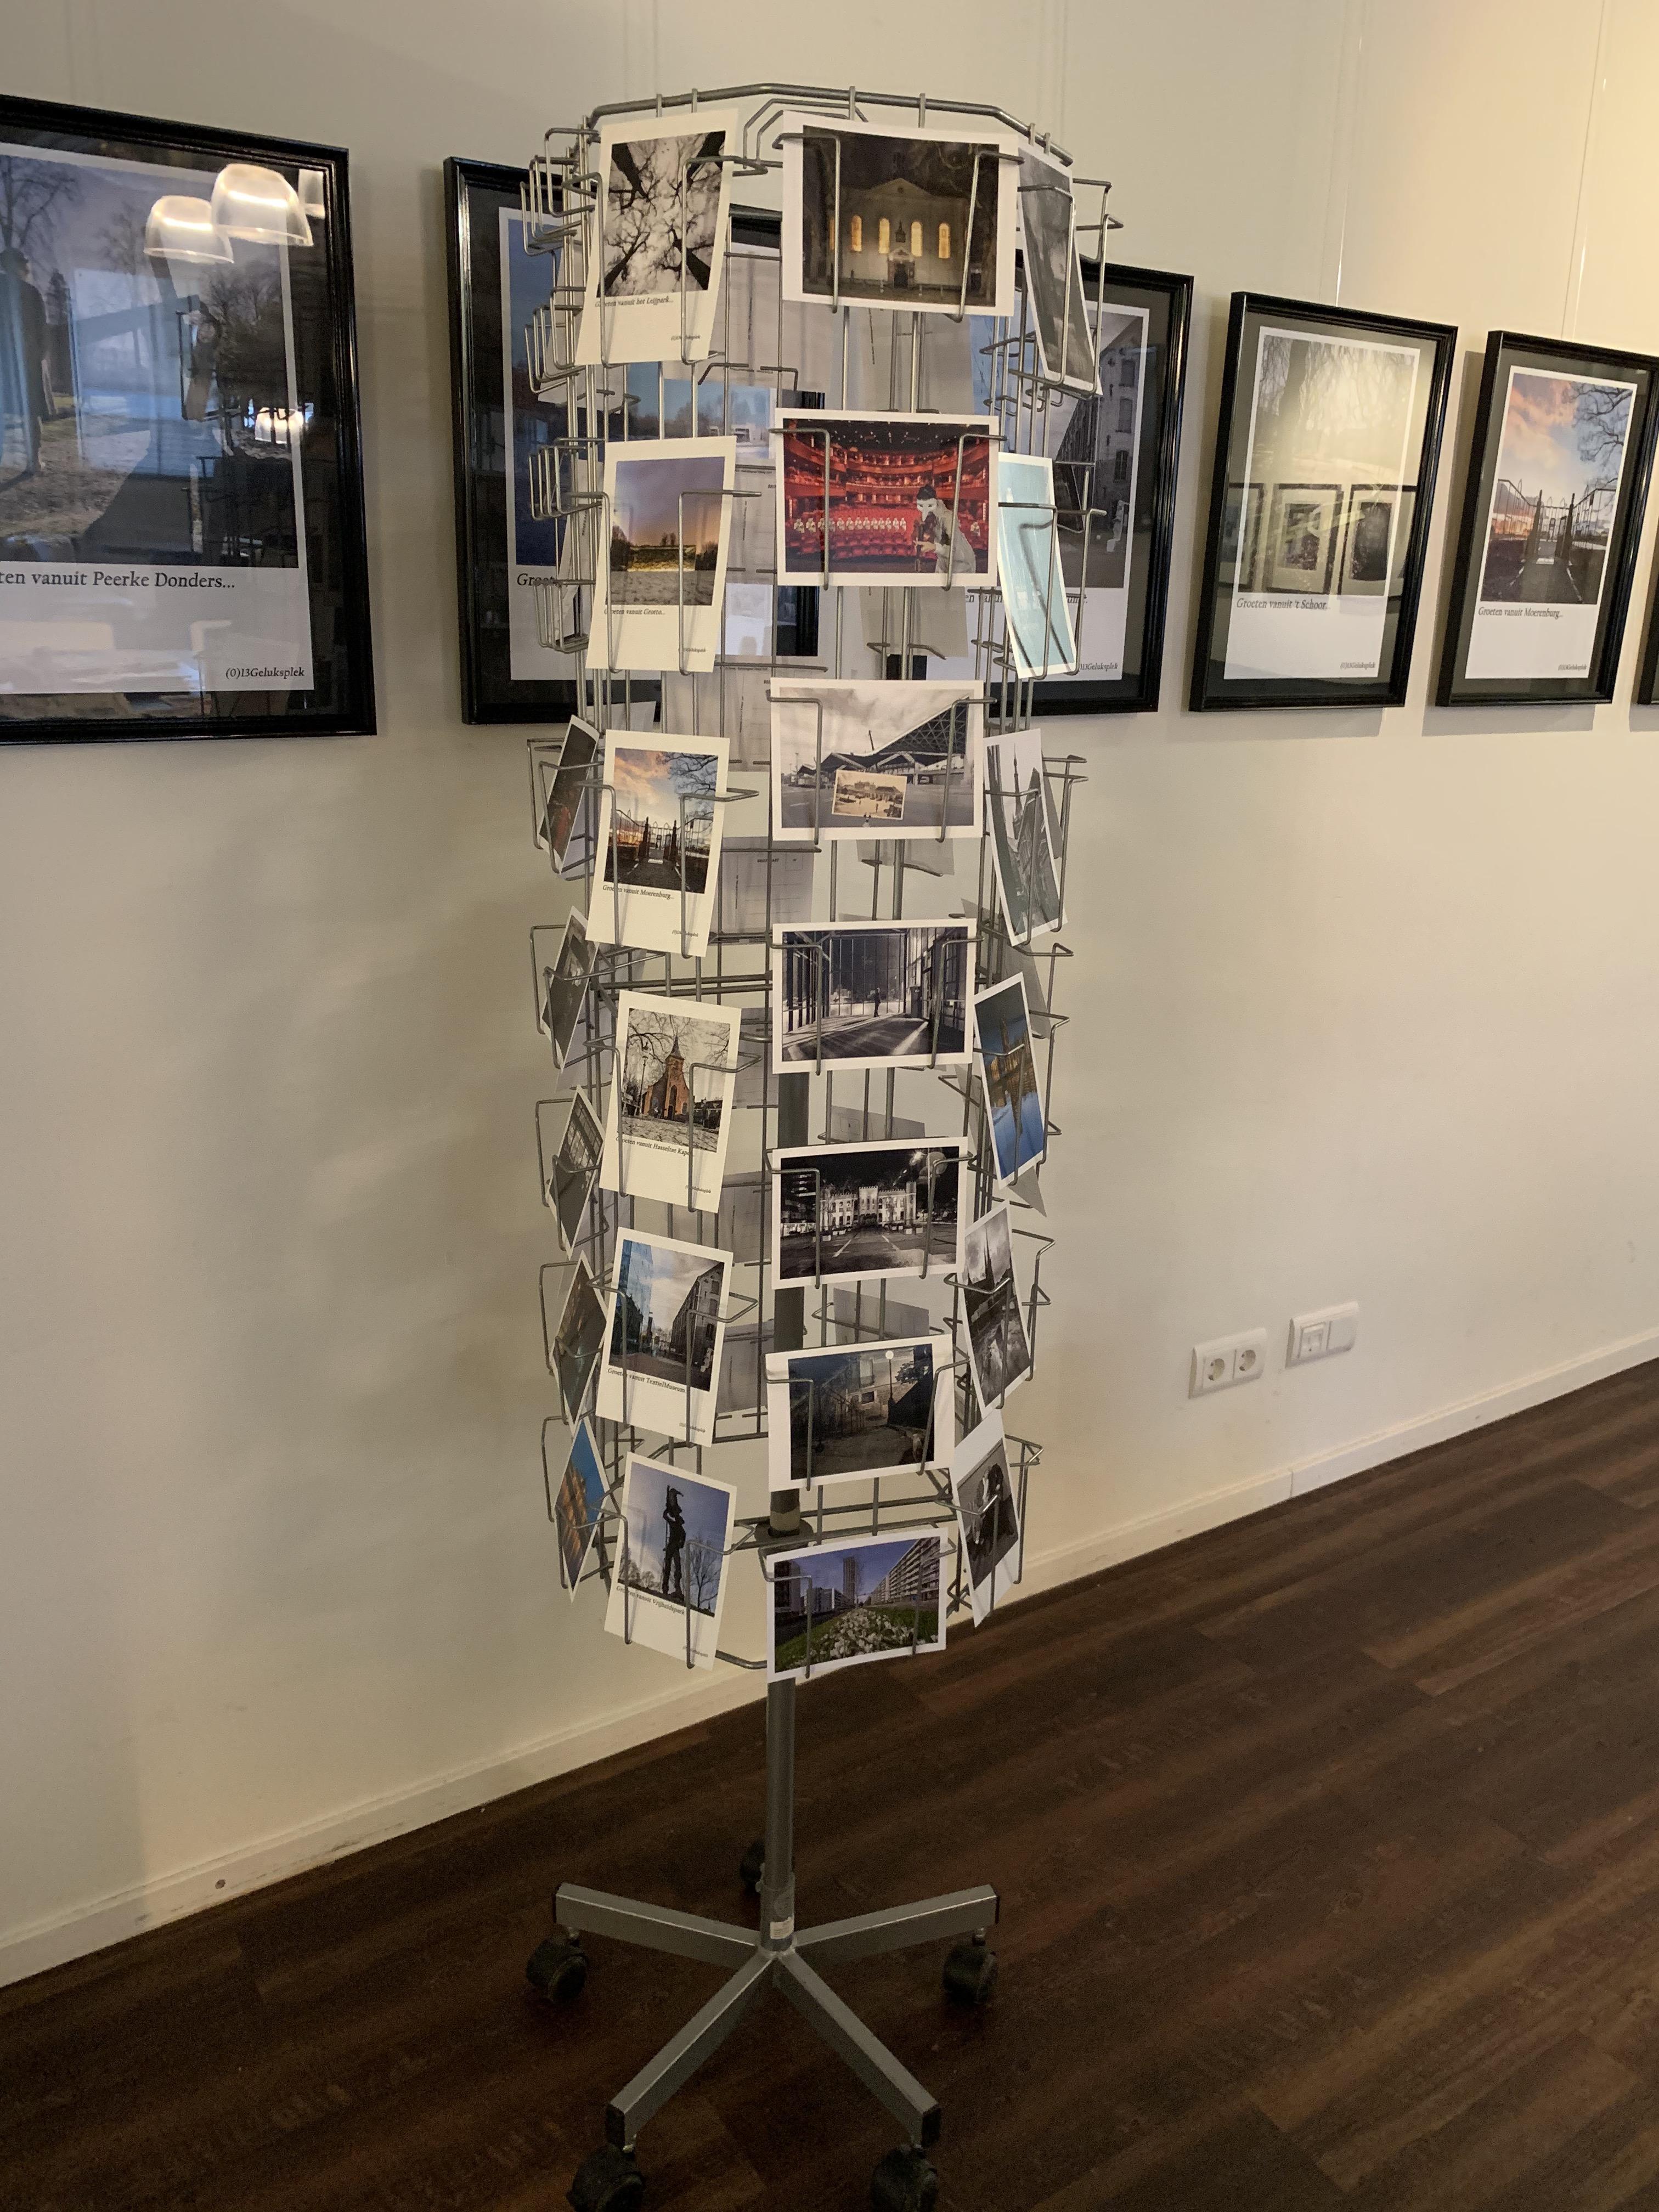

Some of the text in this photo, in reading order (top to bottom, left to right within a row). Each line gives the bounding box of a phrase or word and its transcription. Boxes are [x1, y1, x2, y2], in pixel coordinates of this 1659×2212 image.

[31, 571, 88, 585] vanuit
[92, 571, 150, 586] Peerke
[154, 572, 235, 588] Donders...
[1236, 597, 1267, 608] Groeten
[1269, 598, 1293, 609] vanuit
[1478, 606, 1503, 616] Groeten
[1504, 607, 1523, 616] vanuit
